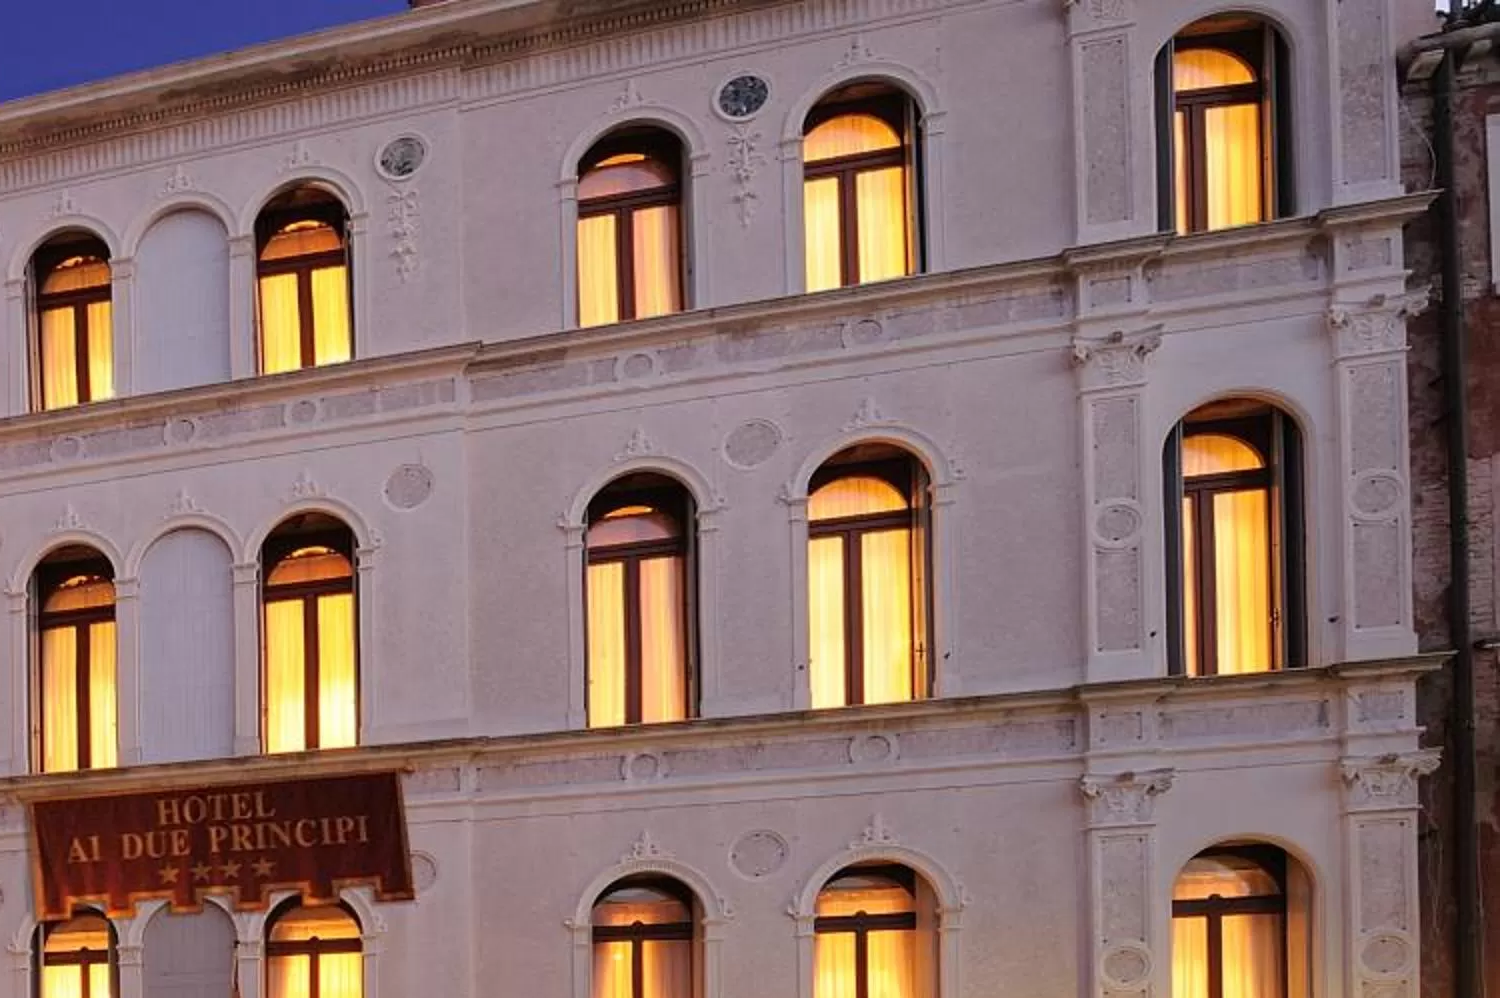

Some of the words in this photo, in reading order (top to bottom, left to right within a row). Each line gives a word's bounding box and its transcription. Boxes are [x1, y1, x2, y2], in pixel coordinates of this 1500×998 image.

[159, 792, 275, 825] HOTEL
[68, 838, 100, 862] AI
[122, 829, 190, 859] DUE
[210, 815, 368, 853] PRINCIPI
